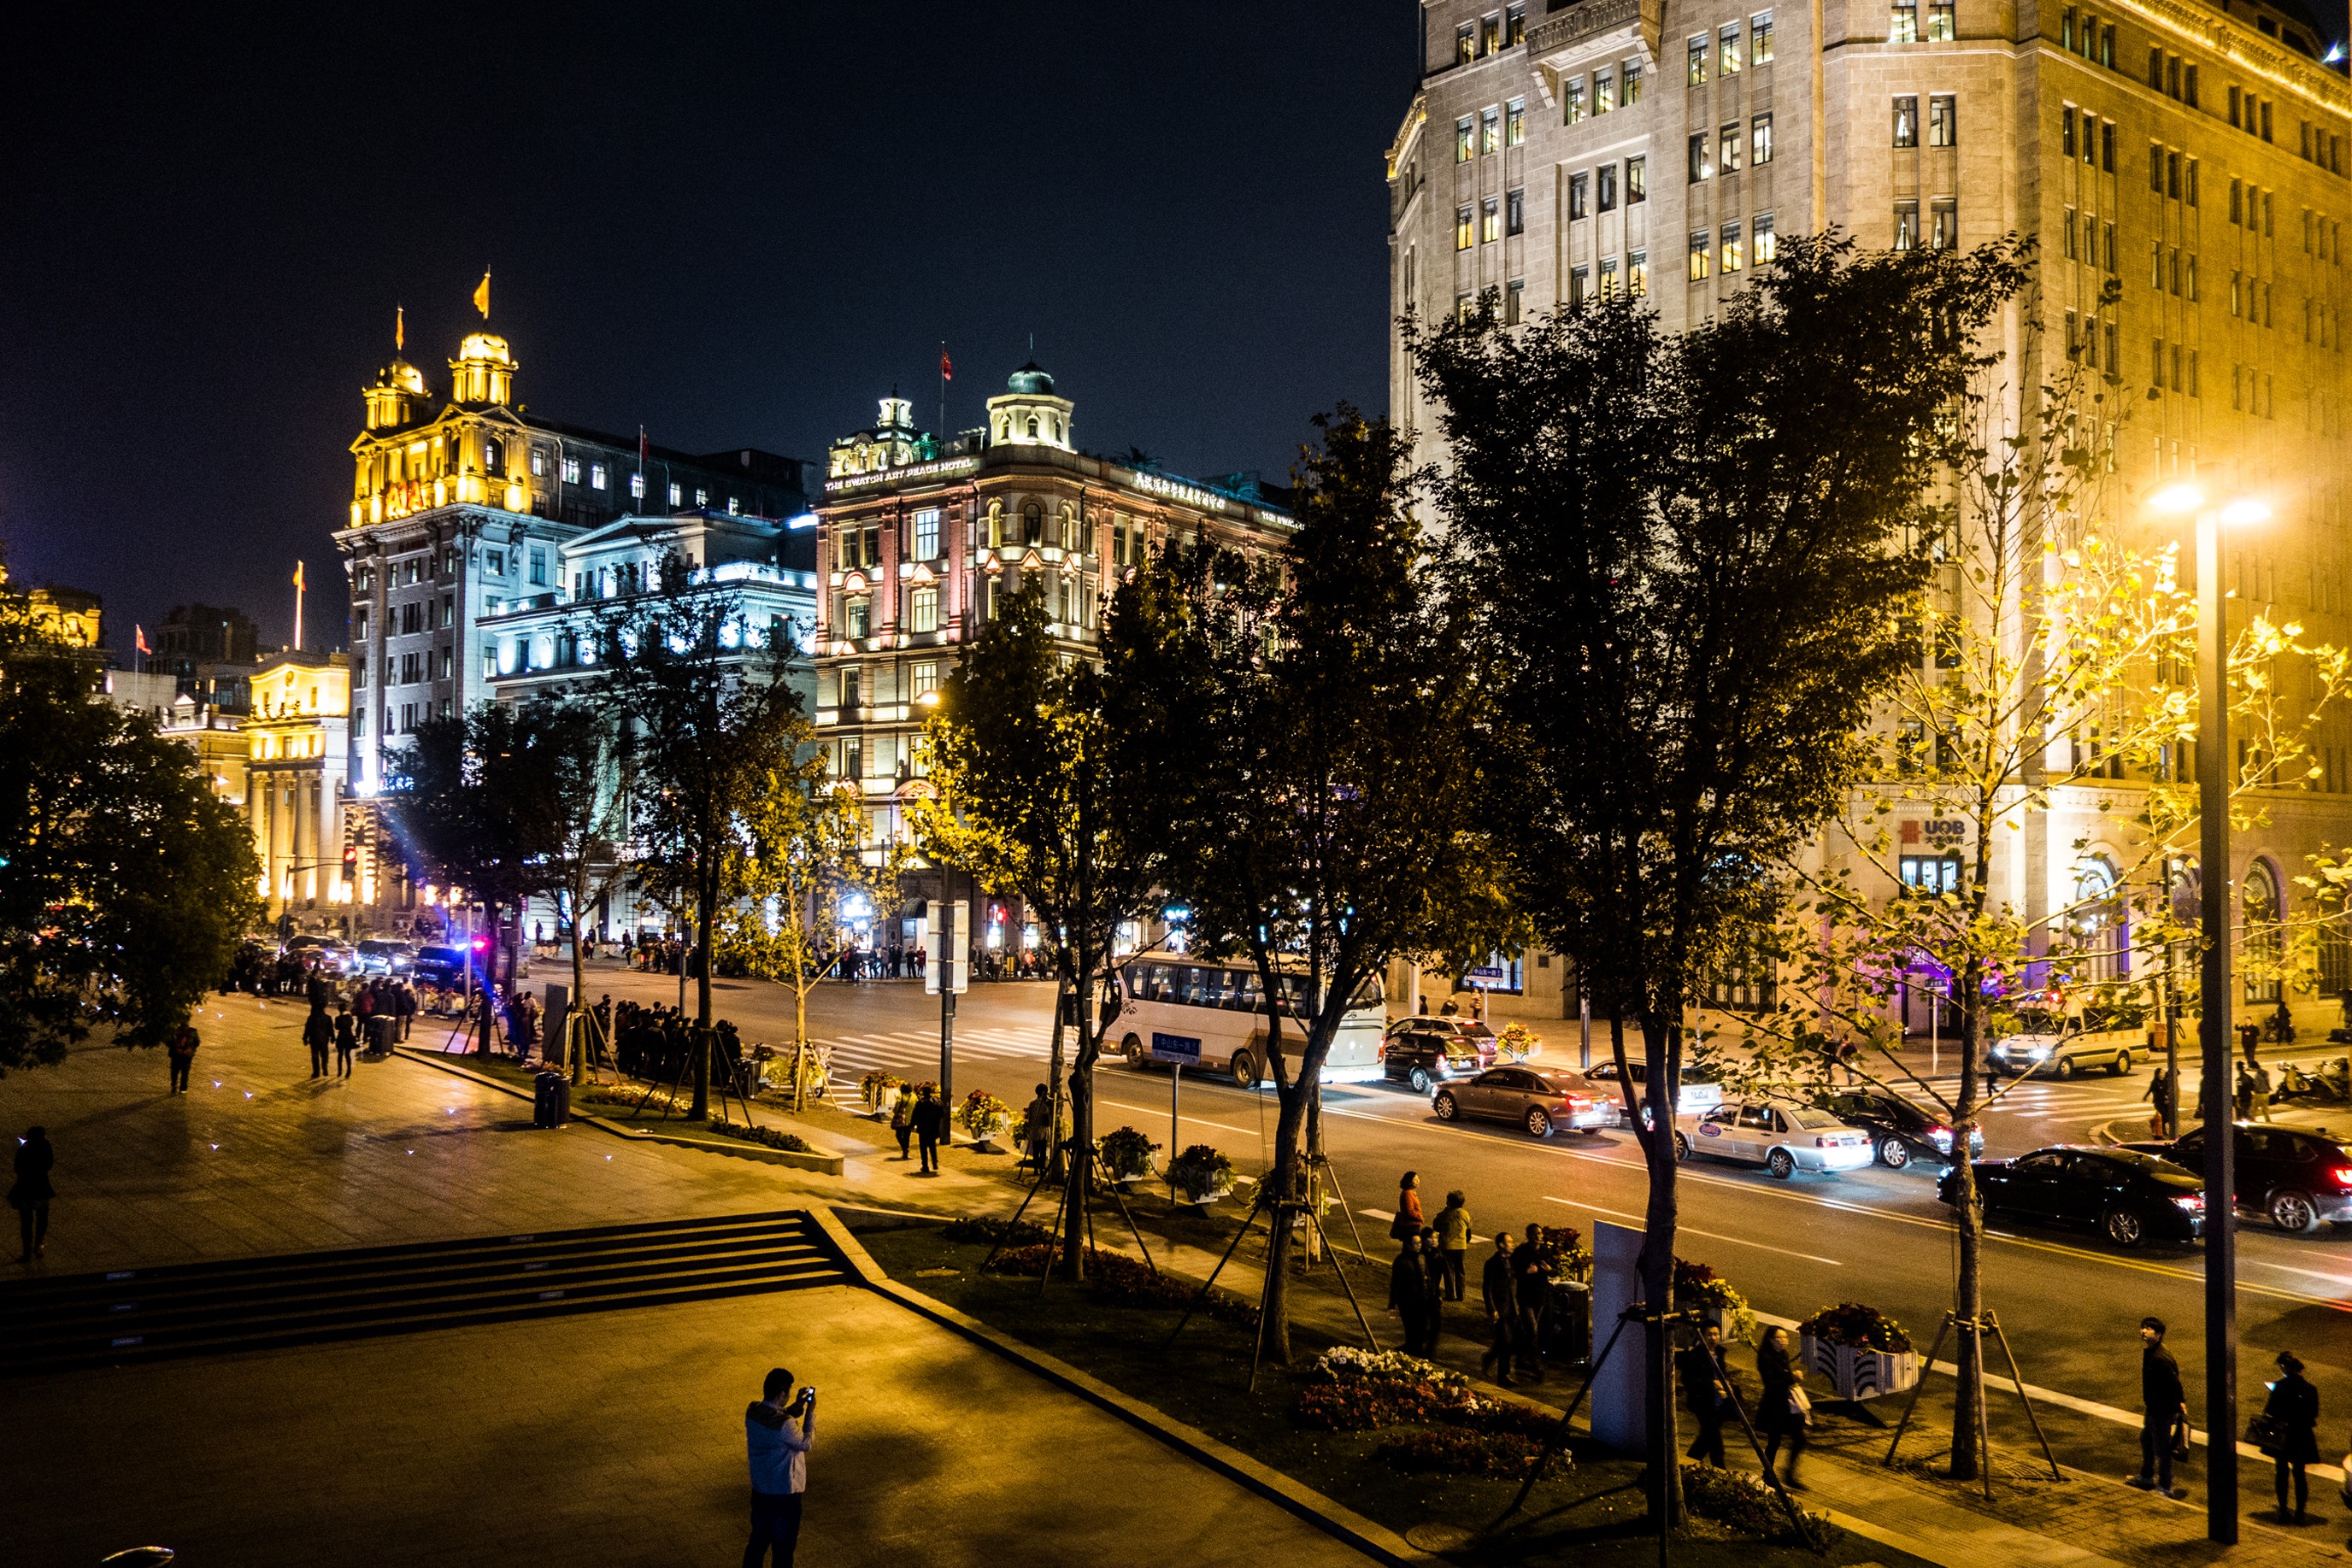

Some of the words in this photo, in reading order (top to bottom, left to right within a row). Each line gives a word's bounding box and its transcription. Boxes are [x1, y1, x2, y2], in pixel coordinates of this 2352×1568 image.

[825, 480, 843, 491] THE
[844, 473, 884, 488] SWATCH
[885, 470, 904, 481] ART
[906, 463, 938, 478] PEACE
[940, 458, 973, 472] HOTEL
[1261, 511, 1276, 523] THE
[1925, 820, 1965, 835] UOB
